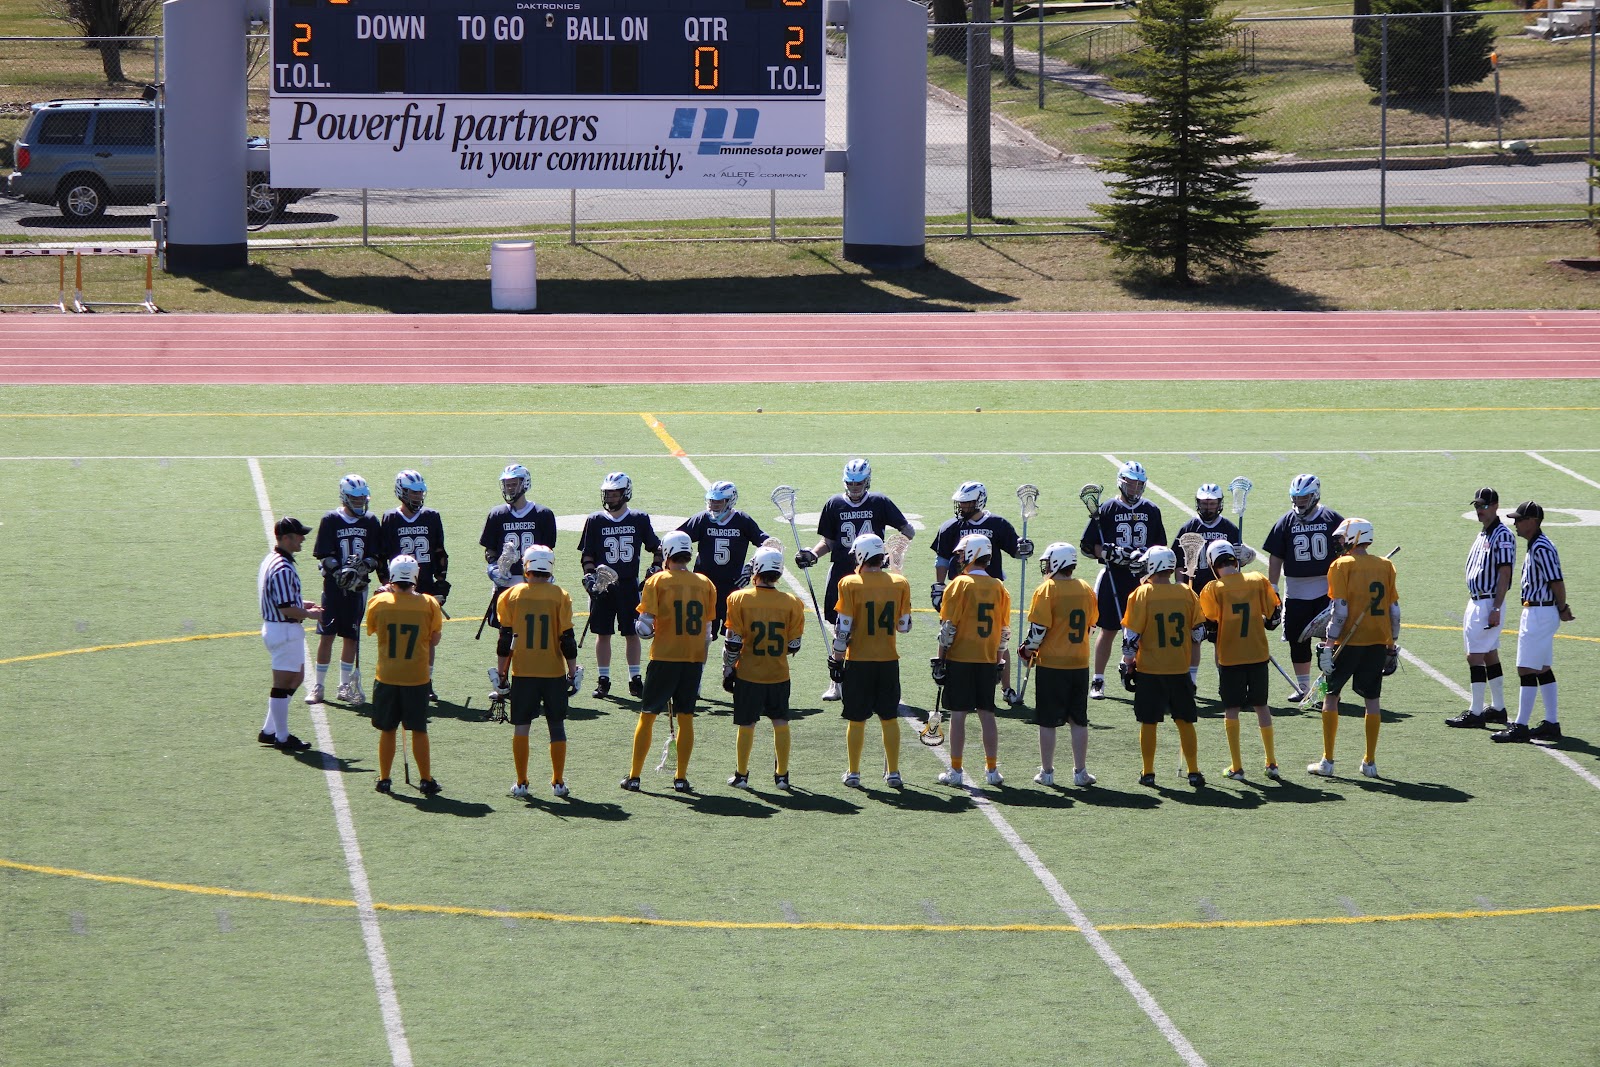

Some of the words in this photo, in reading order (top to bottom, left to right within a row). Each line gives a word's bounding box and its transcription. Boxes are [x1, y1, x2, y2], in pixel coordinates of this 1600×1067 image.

[292, 23, 312, 57] 2
[357, 15, 426, 40] DOWN
[457, 15, 486, 40] TO
[493, 15, 525, 41] GO
[566, 16, 615, 41] BALL
[621, 17, 648, 41] ON
[684, 17, 728, 42] QTR
[785, 26, 804, 59] 2
[276, 63, 331, 88] T.O.L.
[694, 46, 719, 90] 0
[766, 65, 821, 90] T.O.L.
[288, 101, 446, 152] Powerful
[451, 109, 599, 152] partners
[460, 145, 483, 171] in
[487, 151, 543, 179] your
[546, 145, 684, 179] community.
[719, 145, 784, 156] minnesota
[785, 146, 825, 157] power
[839, 510, 874, 521] CHARGERS
[1291, 523, 1328, 534] CHARGERS
[397, 526, 429, 536] CHARGERS
[601, 526, 636, 536] CHARGERS
[706, 527, 741, 537] CHARGERS
[840, 519, 874, 548] 34
[1115, 522, 1148, 548] 33
[400, 536, 431, 563] 22
[603, 536, 635, 564] 35
[713, 538, 731, 566] 5
[1293, 533, 1328, 562] 20
[1369, 581, 1385, 616] 2
[524, 613, 549, 650] 11
[674, 600, 704, 636] 18
[865, 600, 895, 636] 14
[977, 602, 995, 638] 5
[1068, 608, 1086, 644] 9
[1154, 612, 1185, 648] 13
[1232, 602, 1250, 638] 7
[387, 623, 420, 660] 17
[751, 621, 786, 657] 25
